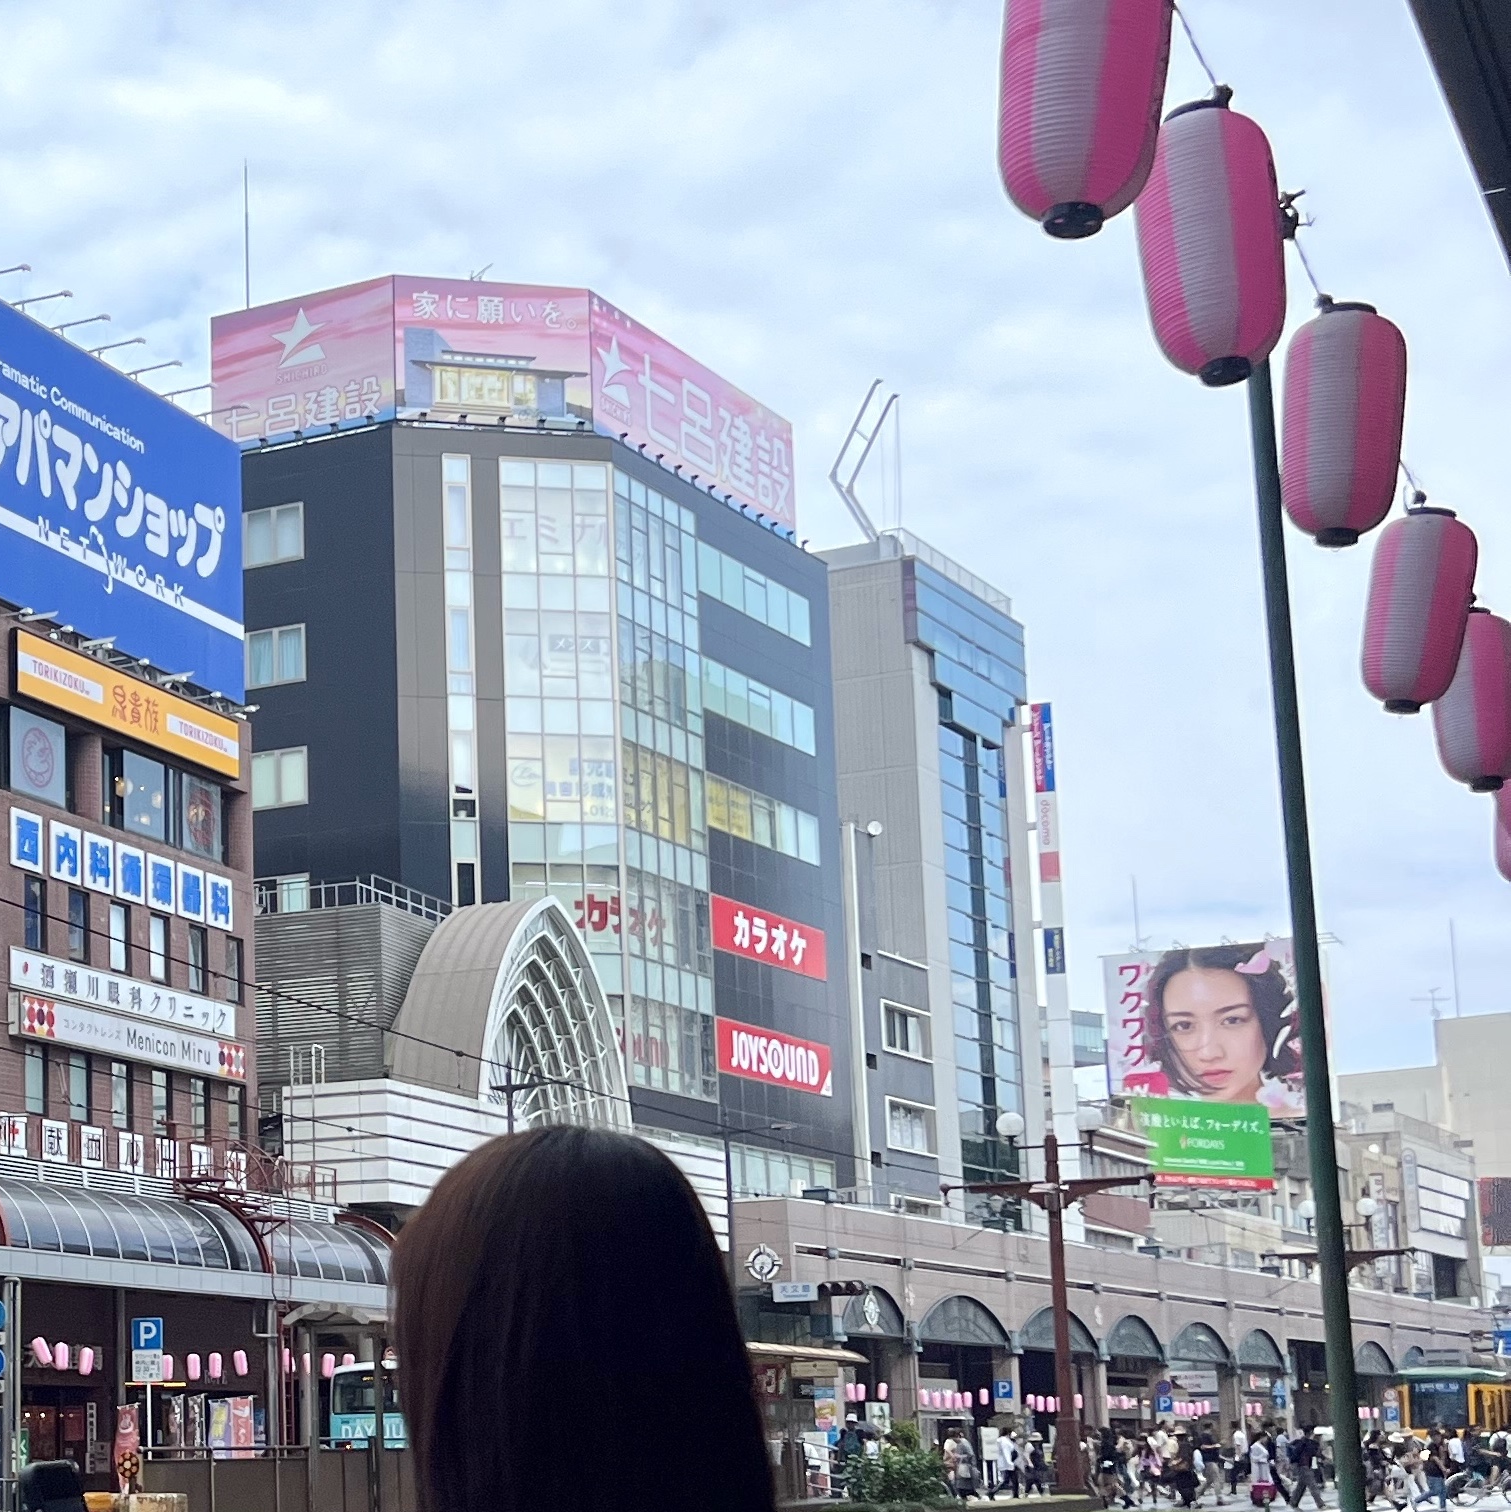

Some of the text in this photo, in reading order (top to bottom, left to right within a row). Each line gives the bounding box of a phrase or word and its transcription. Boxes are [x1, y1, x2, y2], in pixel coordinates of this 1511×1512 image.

[411, 291, 579, 332] 家に願いを。
[49, 386, 145, 455] Communication
[225, 377, 382, 443] 七呂建設
[639, 353, 793, 523] 七呂建設
[31, 659, 86, 694] TORIKIZOKU
[178, 720, 225, 752] TORIKIZOKU
[1041, 799, 1051, 846] docomo
[732, 910, 808, 966] カラオケ
[1117, 964, 1147, 1068] ワクワク
[63, 1018, 212, 1066] コンタクトレンズ Menicon Miru
[731, 1029, 820, 1087] JOYSOUND
[139, 1321, 157, 1348] P
[998, 1384, 1010, 1397] P
